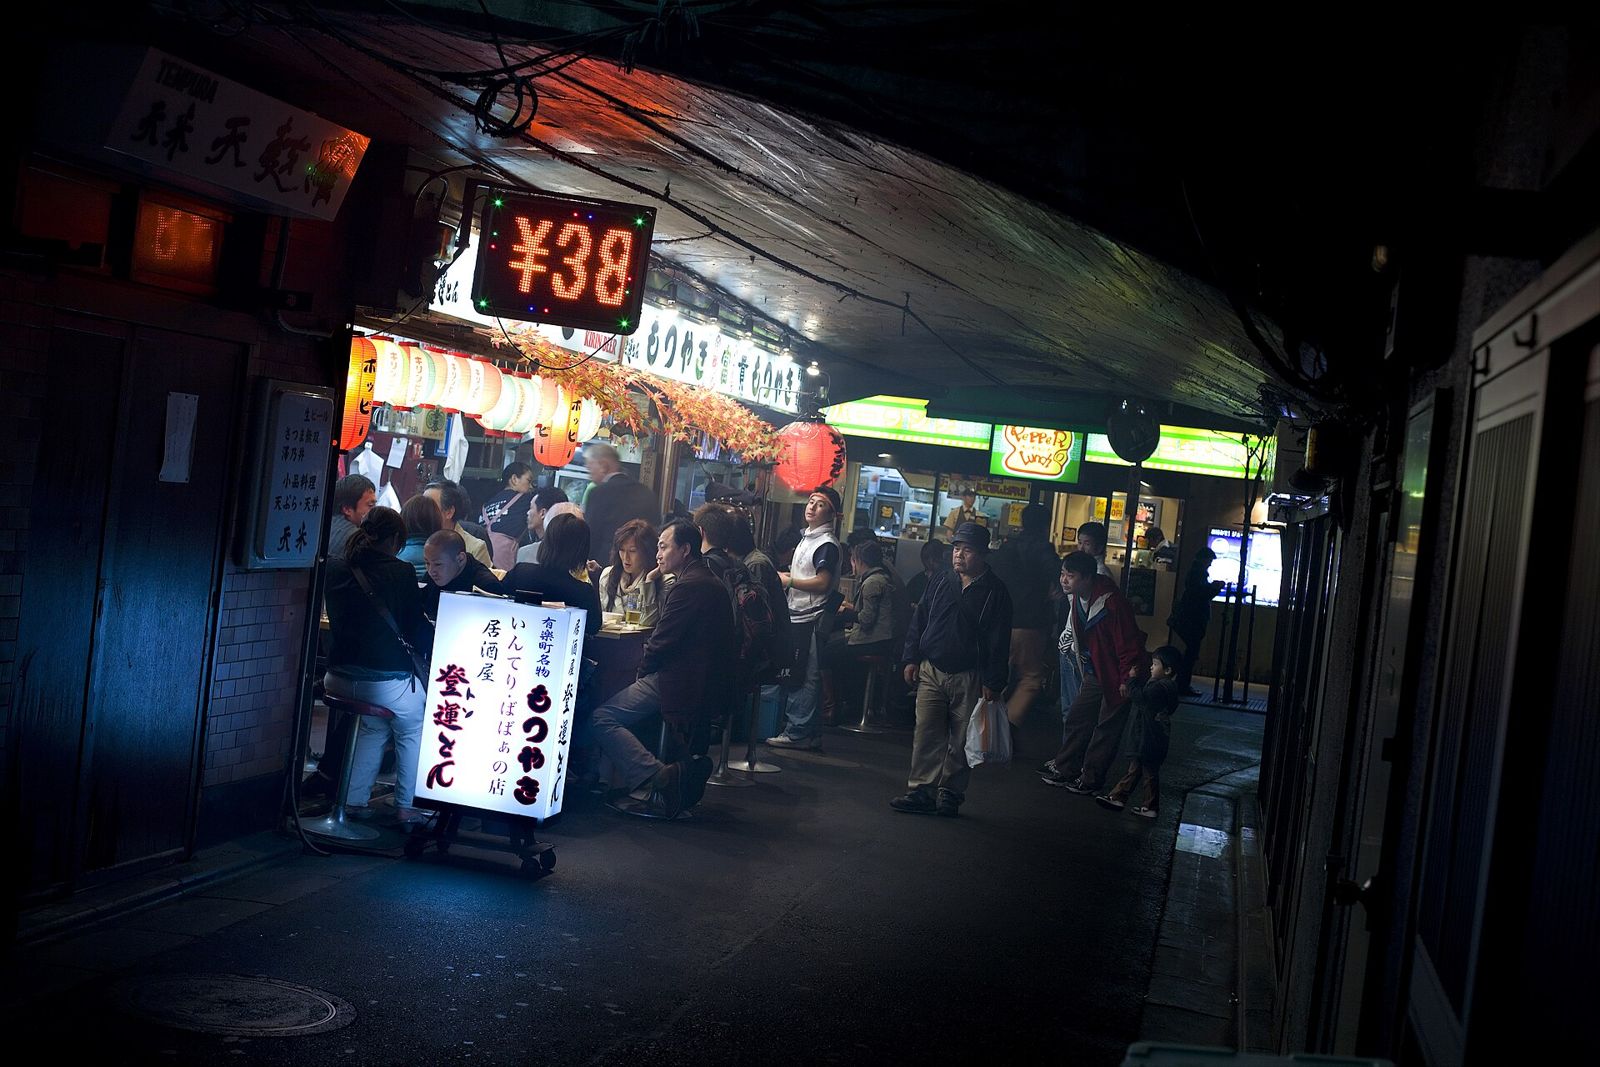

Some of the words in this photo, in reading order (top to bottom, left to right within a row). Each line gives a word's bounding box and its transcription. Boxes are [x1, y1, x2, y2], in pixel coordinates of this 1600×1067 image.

[508, 216, 633, 306] ¥38
[647, 320, 708, 381] もつやき
[283, 473, 317, 490] 小品料理
[476, 619, 501, 683] 居酒屋
[535, 616, 557, 678] 有楽町名物
[568, 618, 581, 676] 居酒屋
[425, 663, 470, 790] 登運とん
[514, 684, 552, 805] もつやき
